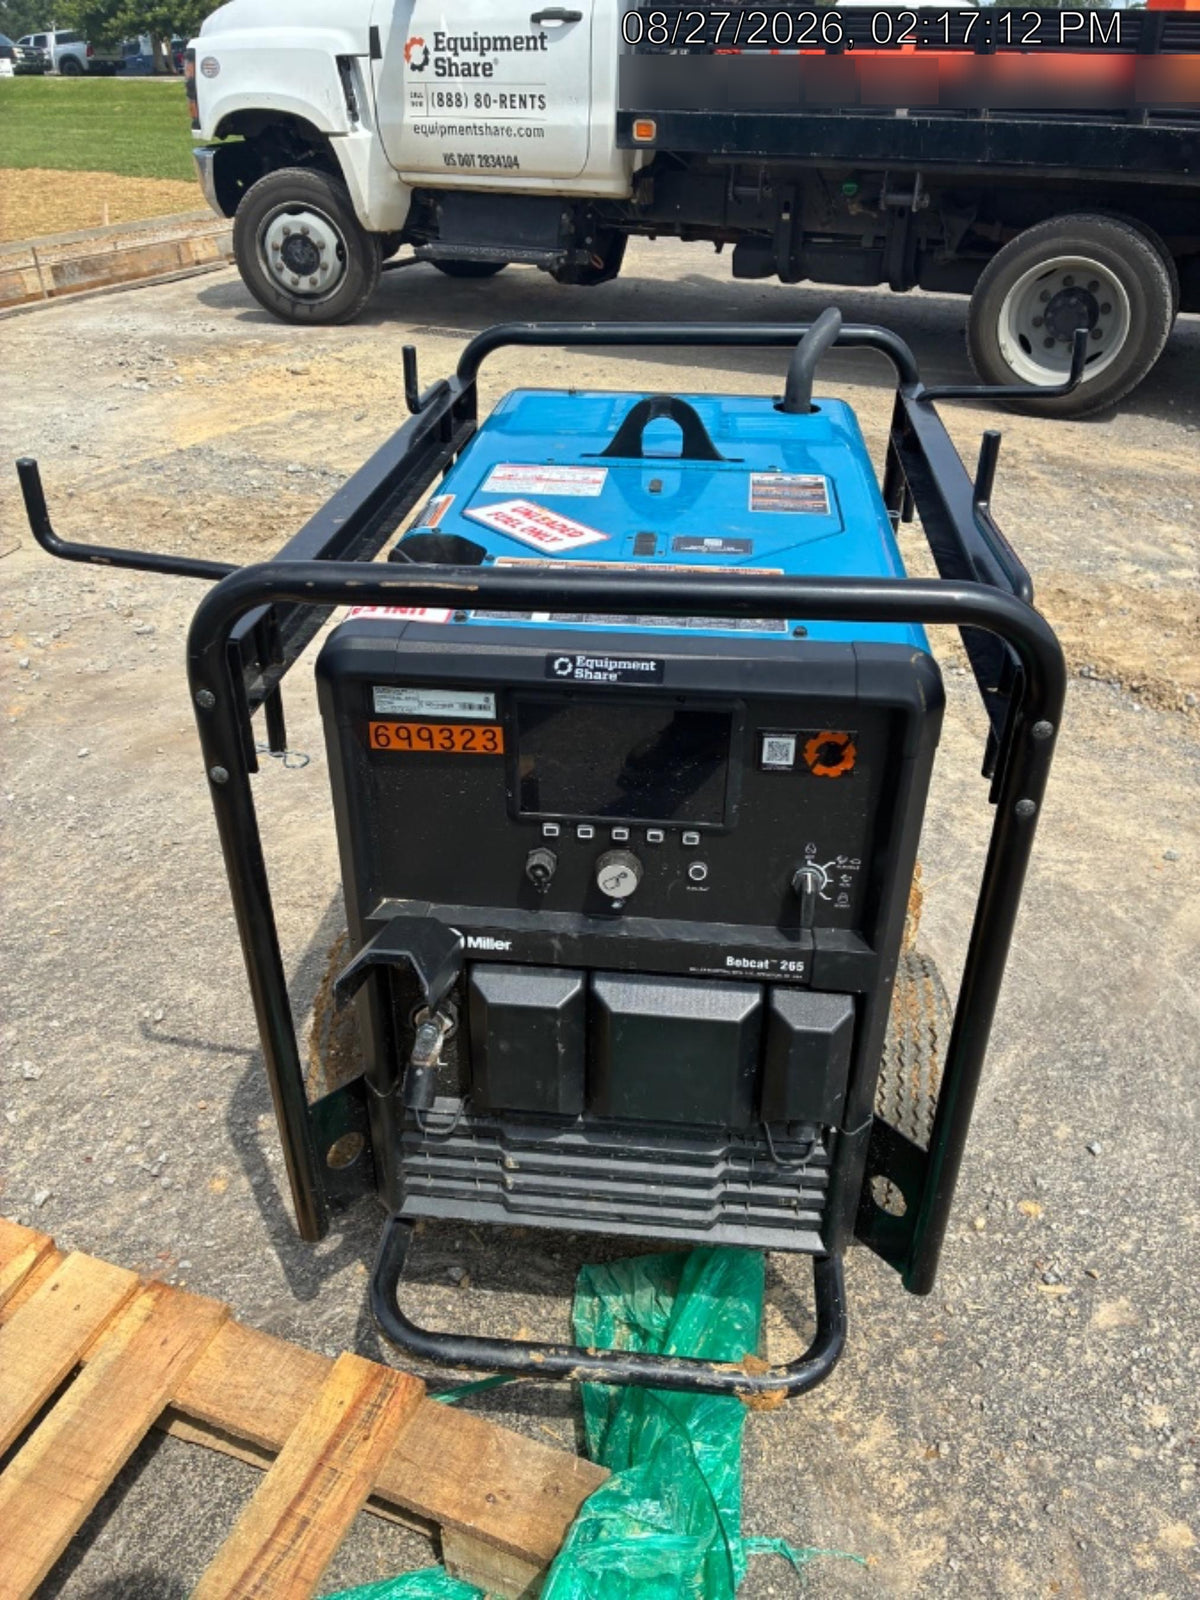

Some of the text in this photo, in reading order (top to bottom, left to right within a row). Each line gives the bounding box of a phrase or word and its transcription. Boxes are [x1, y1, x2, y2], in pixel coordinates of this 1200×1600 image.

[433, 31, 548, 57] Equipment
[431, 91, 547, 110] (888) 80-RENTS
[413, 121, 545, 138] equipmentshare.com
[442, 152, 457, 166] US
[457, 153, 476, 168] DOT
[511, 505, 585, 538] UNLEADED
[575, 655, 657, 672] Equipment
[374, 724, 499, 752] 699323
[467, 935, 512, 951] Miller
[779, 959, 805, 973] 265
